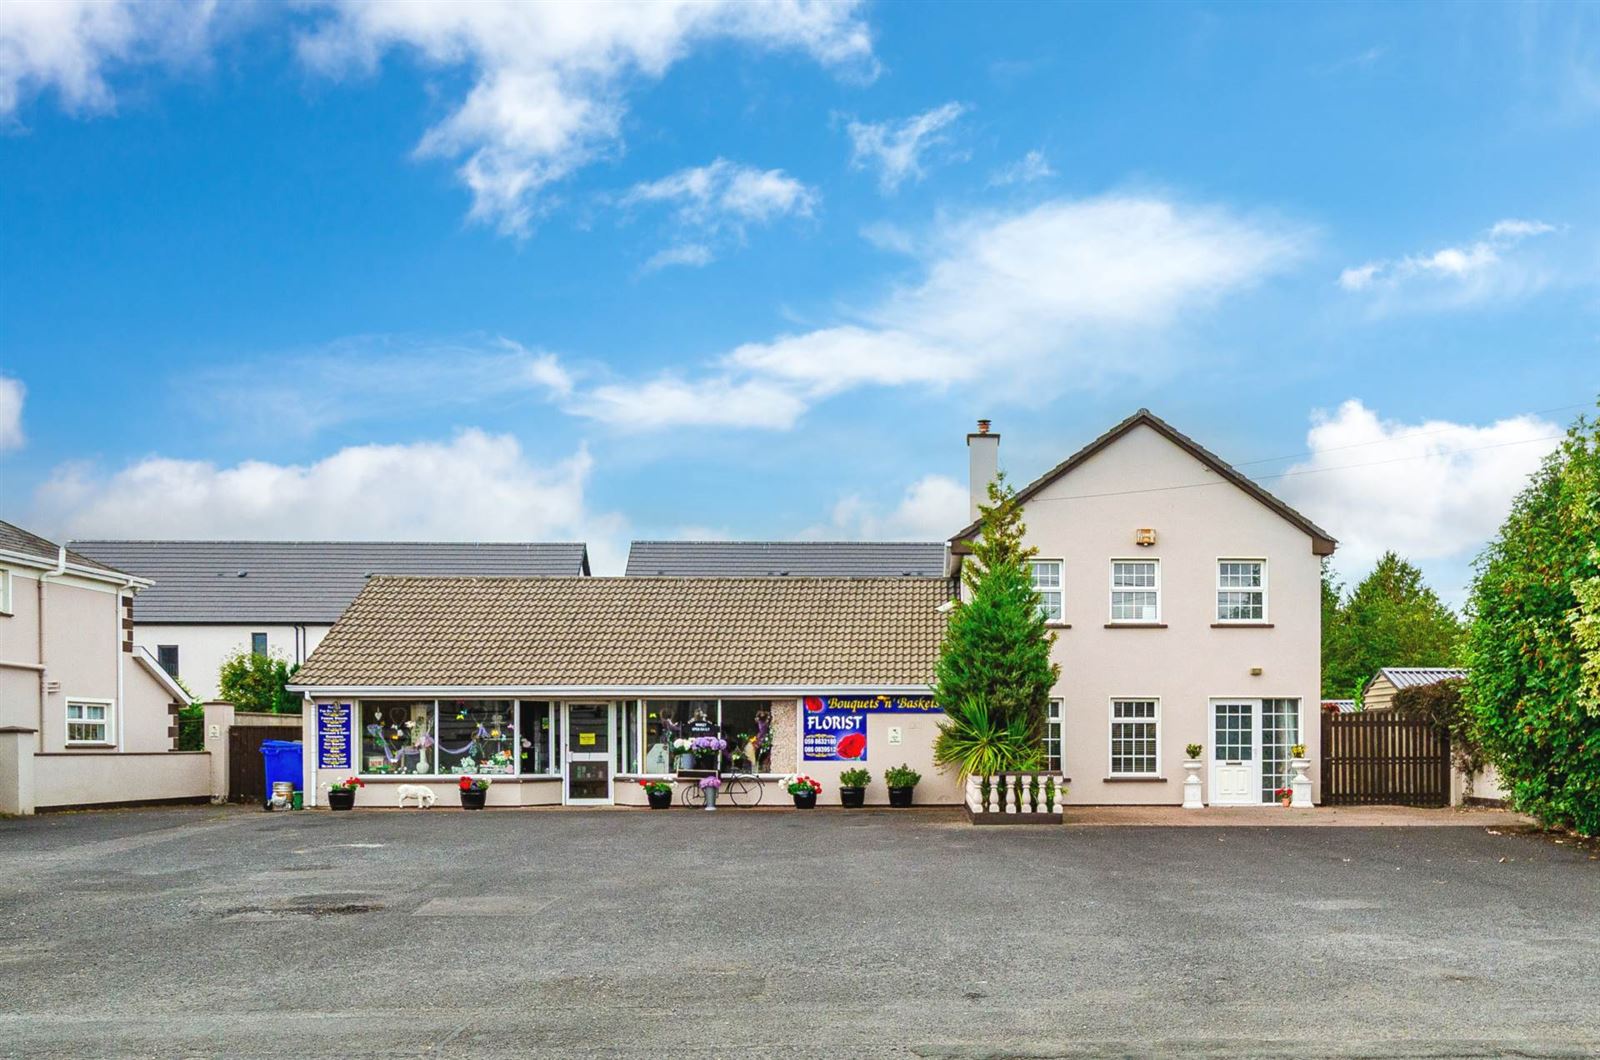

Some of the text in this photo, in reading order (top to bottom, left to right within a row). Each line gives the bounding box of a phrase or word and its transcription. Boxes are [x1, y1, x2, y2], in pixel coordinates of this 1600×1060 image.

[828, 697, 879, 712] Bouquets
[897, 697, 940, 710] Baskets
[807, 715, 863, 730] FLORIST
